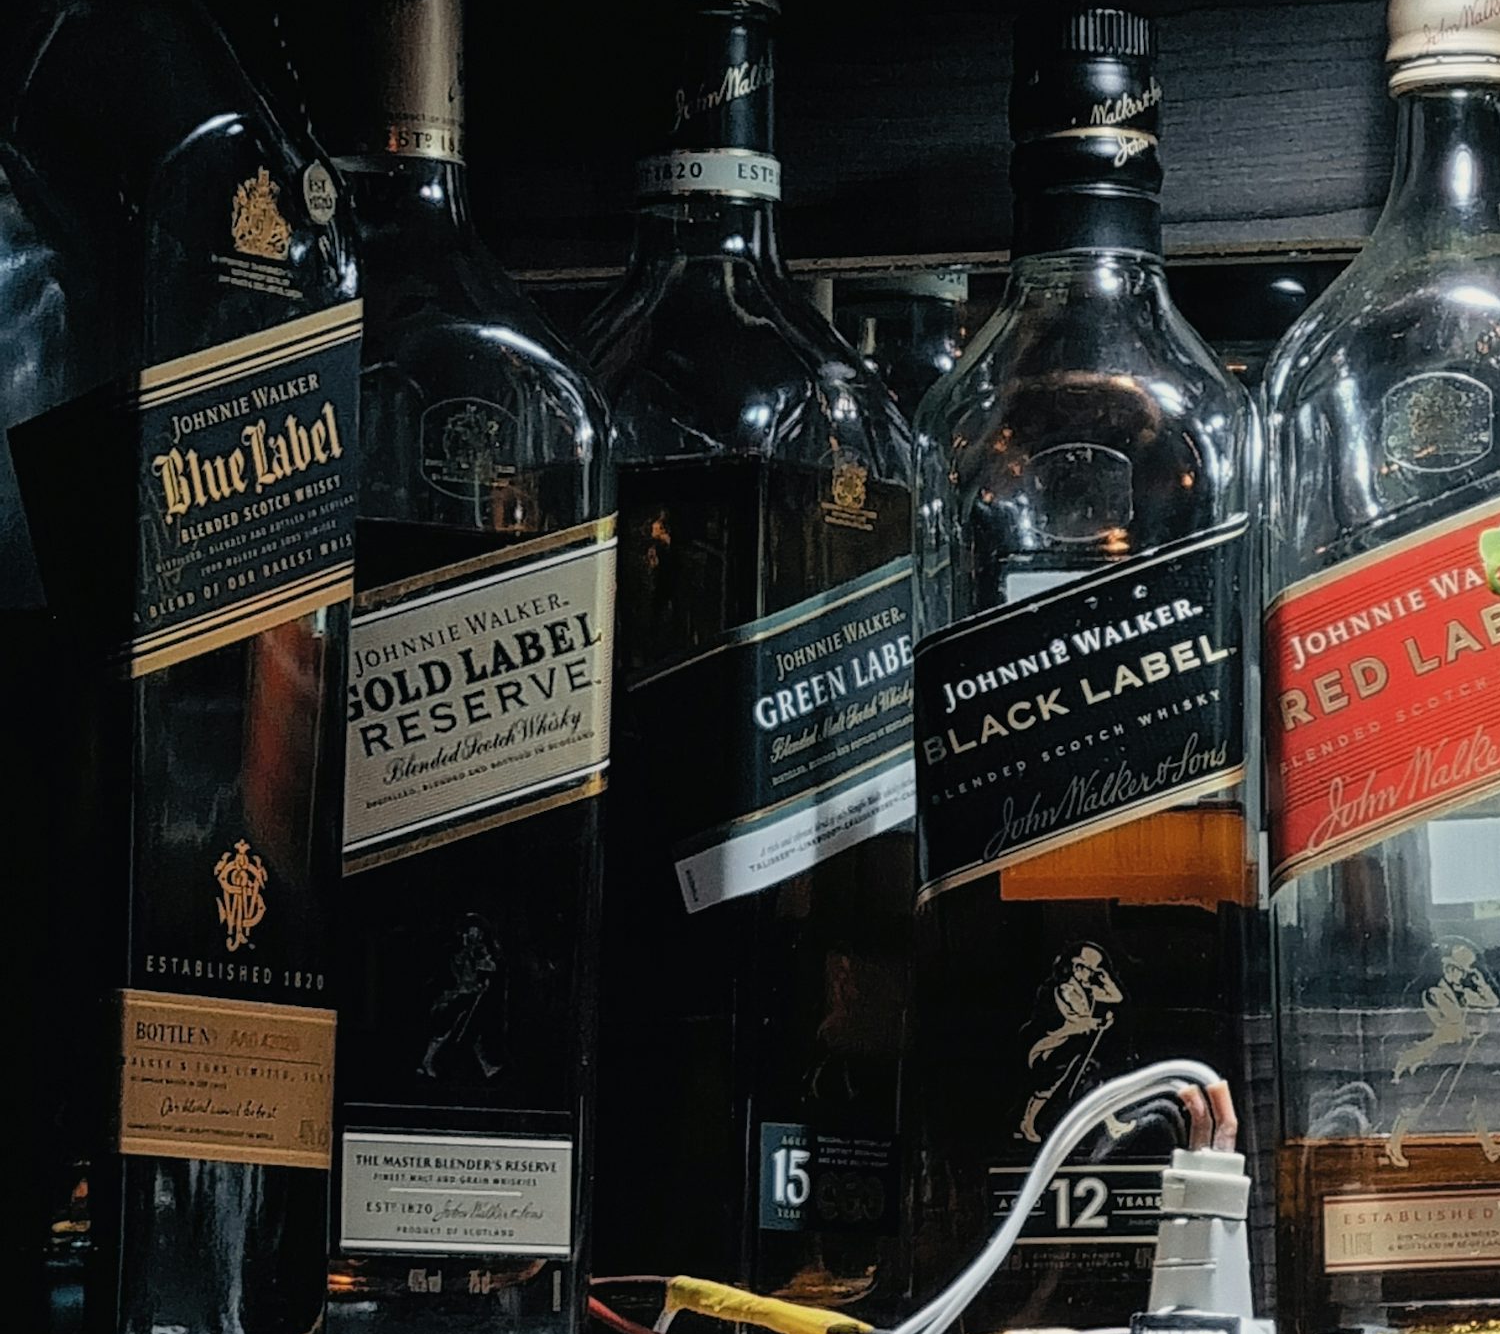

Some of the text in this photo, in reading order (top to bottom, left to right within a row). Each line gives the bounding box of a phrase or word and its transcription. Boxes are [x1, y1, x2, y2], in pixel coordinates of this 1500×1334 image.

[172, 372, 321, 444] JOHNNIE WALKER
[151, 400, 345, 525] Blue Label
[181, 474, 341, 544] BLENDED SCOTCH WHISKY
[150, 547, 313, 618] BLEND OF OUR RAREST
[354, 593, 565, 679] JOHNNIE WALKER
[458, 612, 602, 686] LABEL
[774, 605, 905, 683] JOHNNIE WALKER
[943, 596, 1203, 714] JOHNNIE WALKER
[1289, 588, 1428, 671] JOHNNIE
[360, 656, 592, 758] RESERVE
[752, 633, 916, 734] GREEN LABE
[922, 633, 1232, 765] BLACK LABEL
[1278, 655, 1390, 733] RED
[383, 704, 583, 786] Blended Scotch Whisky
[769, 721, 819, 764] Blended
[1041, 722, 1126, 763] SCOTCH
[1137, 687, 1222, 728] WHISKY
[1279, 720, 1381, 776] BLENDED
[1396, 679, 1488, 723] SCOTCH
[983, 731, 1229, 861] John Walker Sons
[1308, 768, 1400, 853] John
[145, 954, 326, 991] ESTABLISHED 1820
[136, 1021, 195, 1045] BOTTLE
[356, 1154, 558, 1173] THE MASTER BLENDER'S RESERVE
[410, 1173, 538, 1187] MALT AND GRAIN WHISKIES
[771, 1147, 812, 1208] 15
[396, 1225, 515, 1238] PRODUCT OF SCOTLAND
[400, 1202, 433, 1215] 1820
[1048, 1176, 1163, 1229] 12 YEARS
[1344, 1207, 1494, 1226] ESTABLISHED
